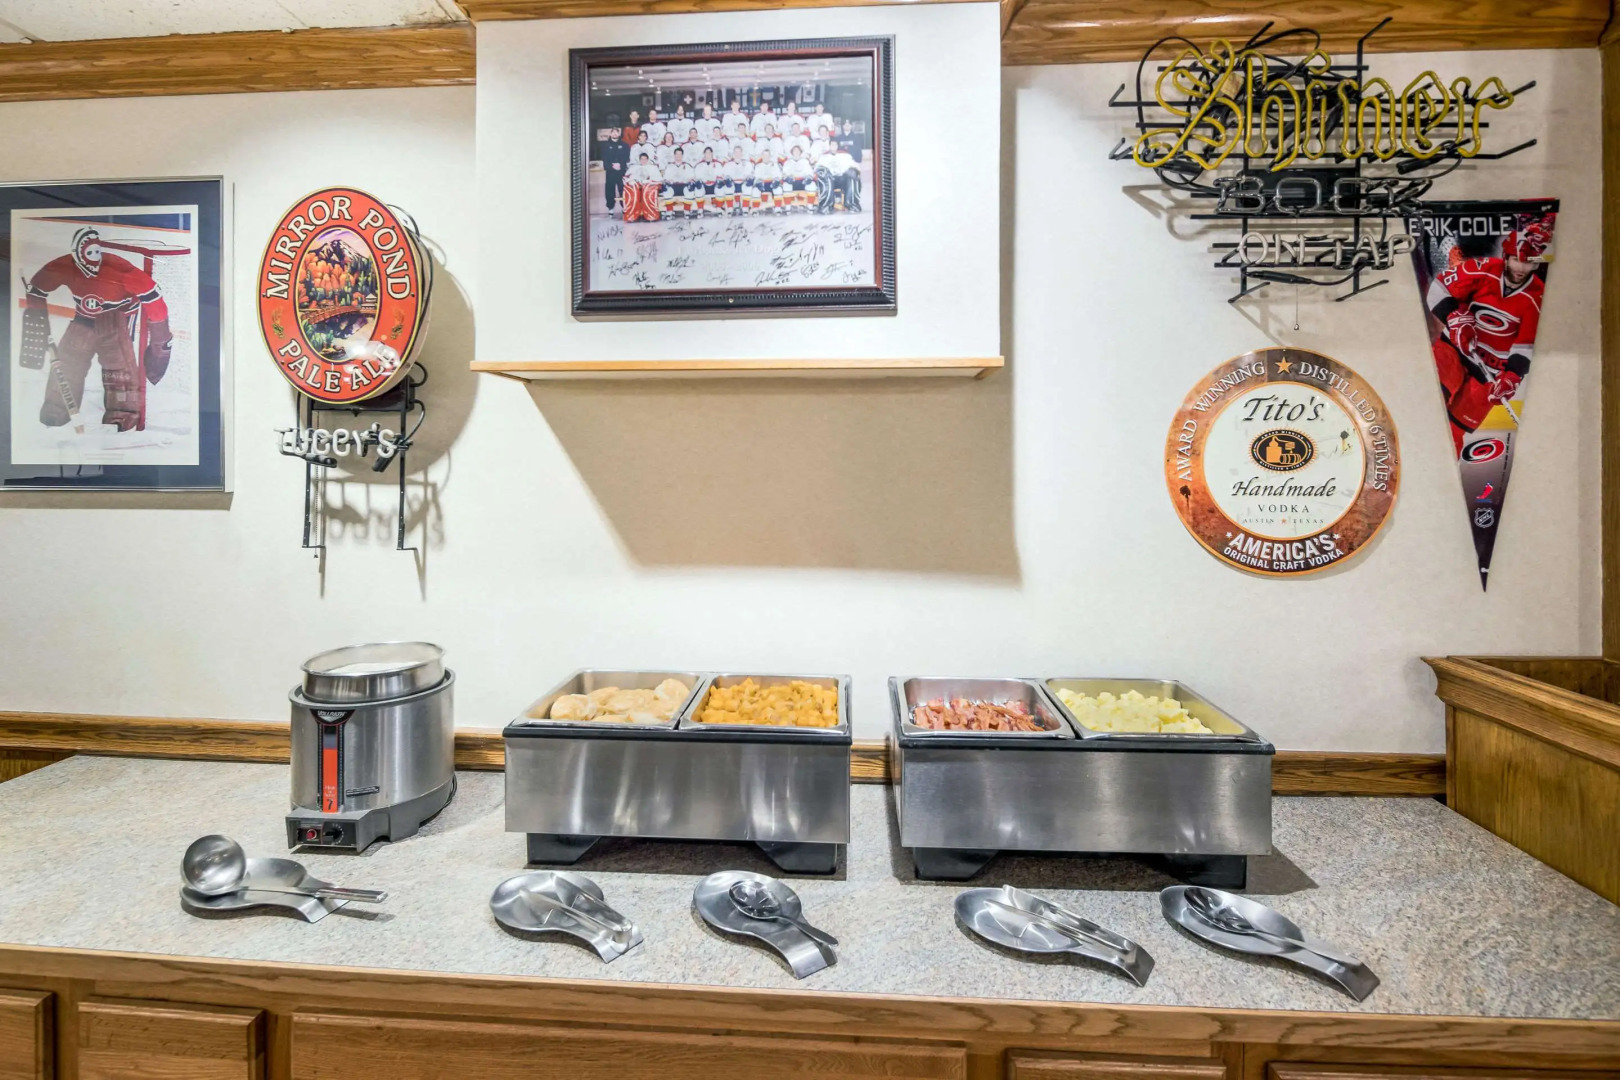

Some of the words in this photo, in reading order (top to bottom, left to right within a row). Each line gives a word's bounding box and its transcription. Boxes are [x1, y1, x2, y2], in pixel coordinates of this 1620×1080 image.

[1133, 38, 1514, 172] Shiner
[1408, 216, 1457, 237] ERIK
[1459, 216, 1514, 237] COLE
[266, 196, 353, 300] MIRROR
[358, 208, 412, 300] POND
[1238, 231, 1306, 266] ON
[1327, 232, 1416, 270] TAP
[1442, 267, 1459, 286] 26
[278, 339, 342, 393] PALE
[1194, 361, 1266, 414] WINNING
[1299, 361, 1376, 423] DISTILLED
[1242, 394, 1325, 422] Tito's
[1368, 424, 1384, 435] 6
[1176, 418, 1198, 482] AWARD
[1373, 436, 1390, 493] TIMES
[1231, 476, 1337, 497] Handmade
[1257, 504, 1310, 513] VODKA
[1223, 546, 1270, 569] ORIGINAL
[1273, 560, 1305, 570] CRAFT
[1308, 548, 1345, 567] VODKA
[1228, 532, 1336, 561] AMERICA'S
